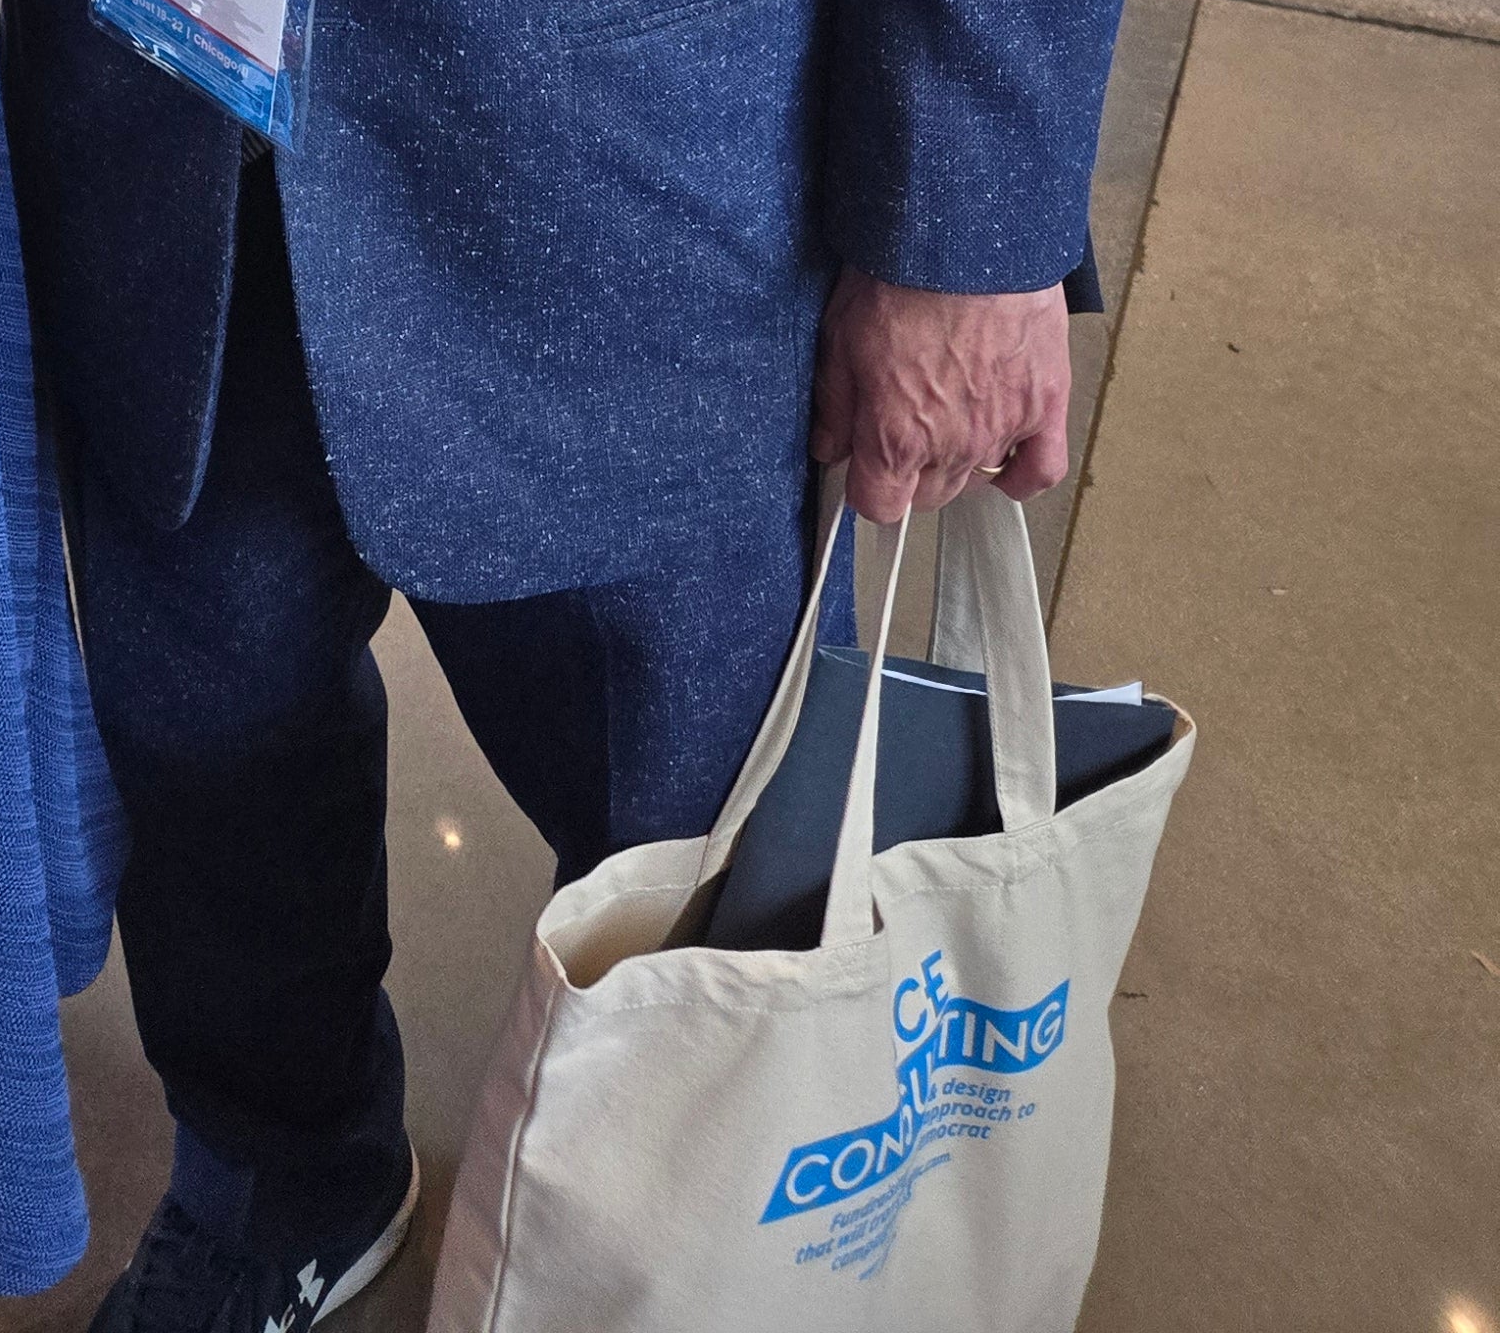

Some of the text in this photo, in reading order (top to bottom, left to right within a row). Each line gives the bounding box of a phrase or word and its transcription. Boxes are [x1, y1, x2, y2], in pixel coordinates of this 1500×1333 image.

[785, 1001, 1063, 1205] CONUTING
[942, 1079, 1011, 1104] design
[1017, 1102, 1036, 1120] to
[794, 1237, 835, 1265] that
